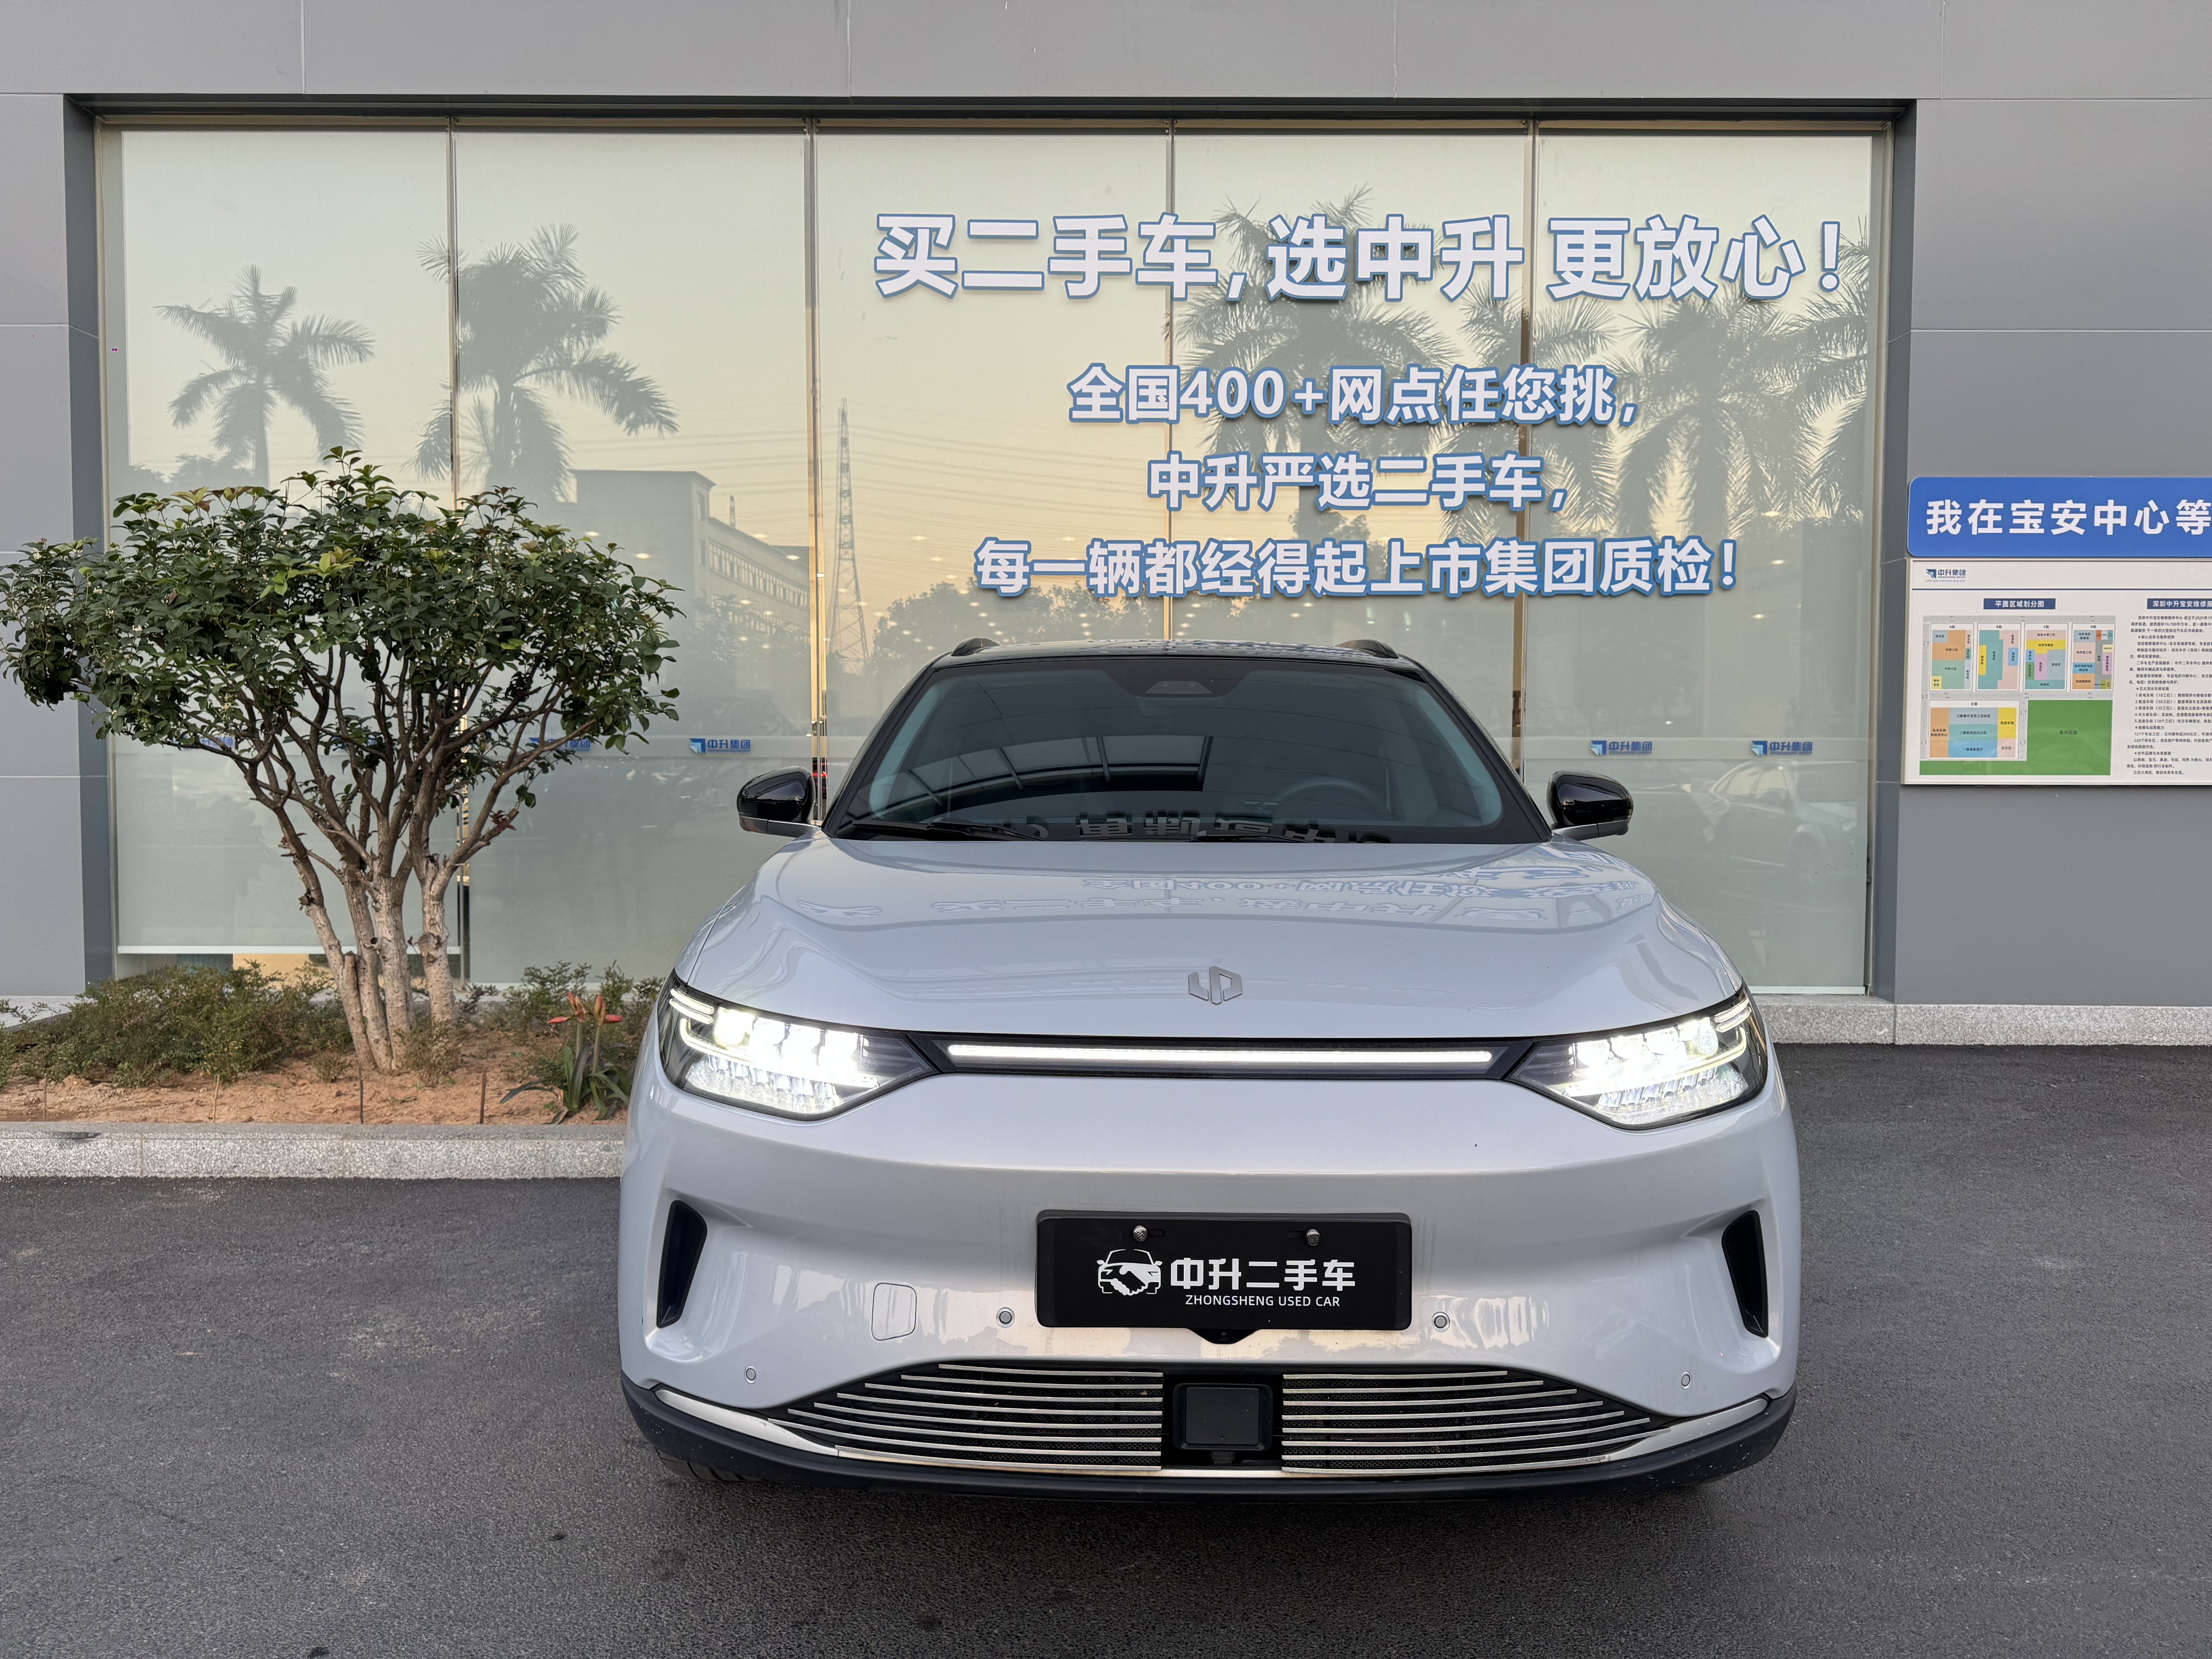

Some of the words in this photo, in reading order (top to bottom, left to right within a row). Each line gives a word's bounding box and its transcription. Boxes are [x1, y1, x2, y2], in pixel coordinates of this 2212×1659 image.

[1147, 450, 1567, 512] 中升严选二手车，
[1926, 499, 2212, 536] 我在宝安中心等
[974, 536, 1736, 598] 每一辆都经得起上市集团质检！
[708, 739, 750, 749] 中升集团
[1609, 741, 1652, 750] 中升集团
[1770, 741, 1813, 751] 中升集团
[1170, 1257, 1355, 1291] 中升二手车
[1185, 1295, 1274, 1306] ZHONGSHENG
[1278, 1295, 1311, 1307] USED
[1315, 1296, 1340, 1307] CAR
